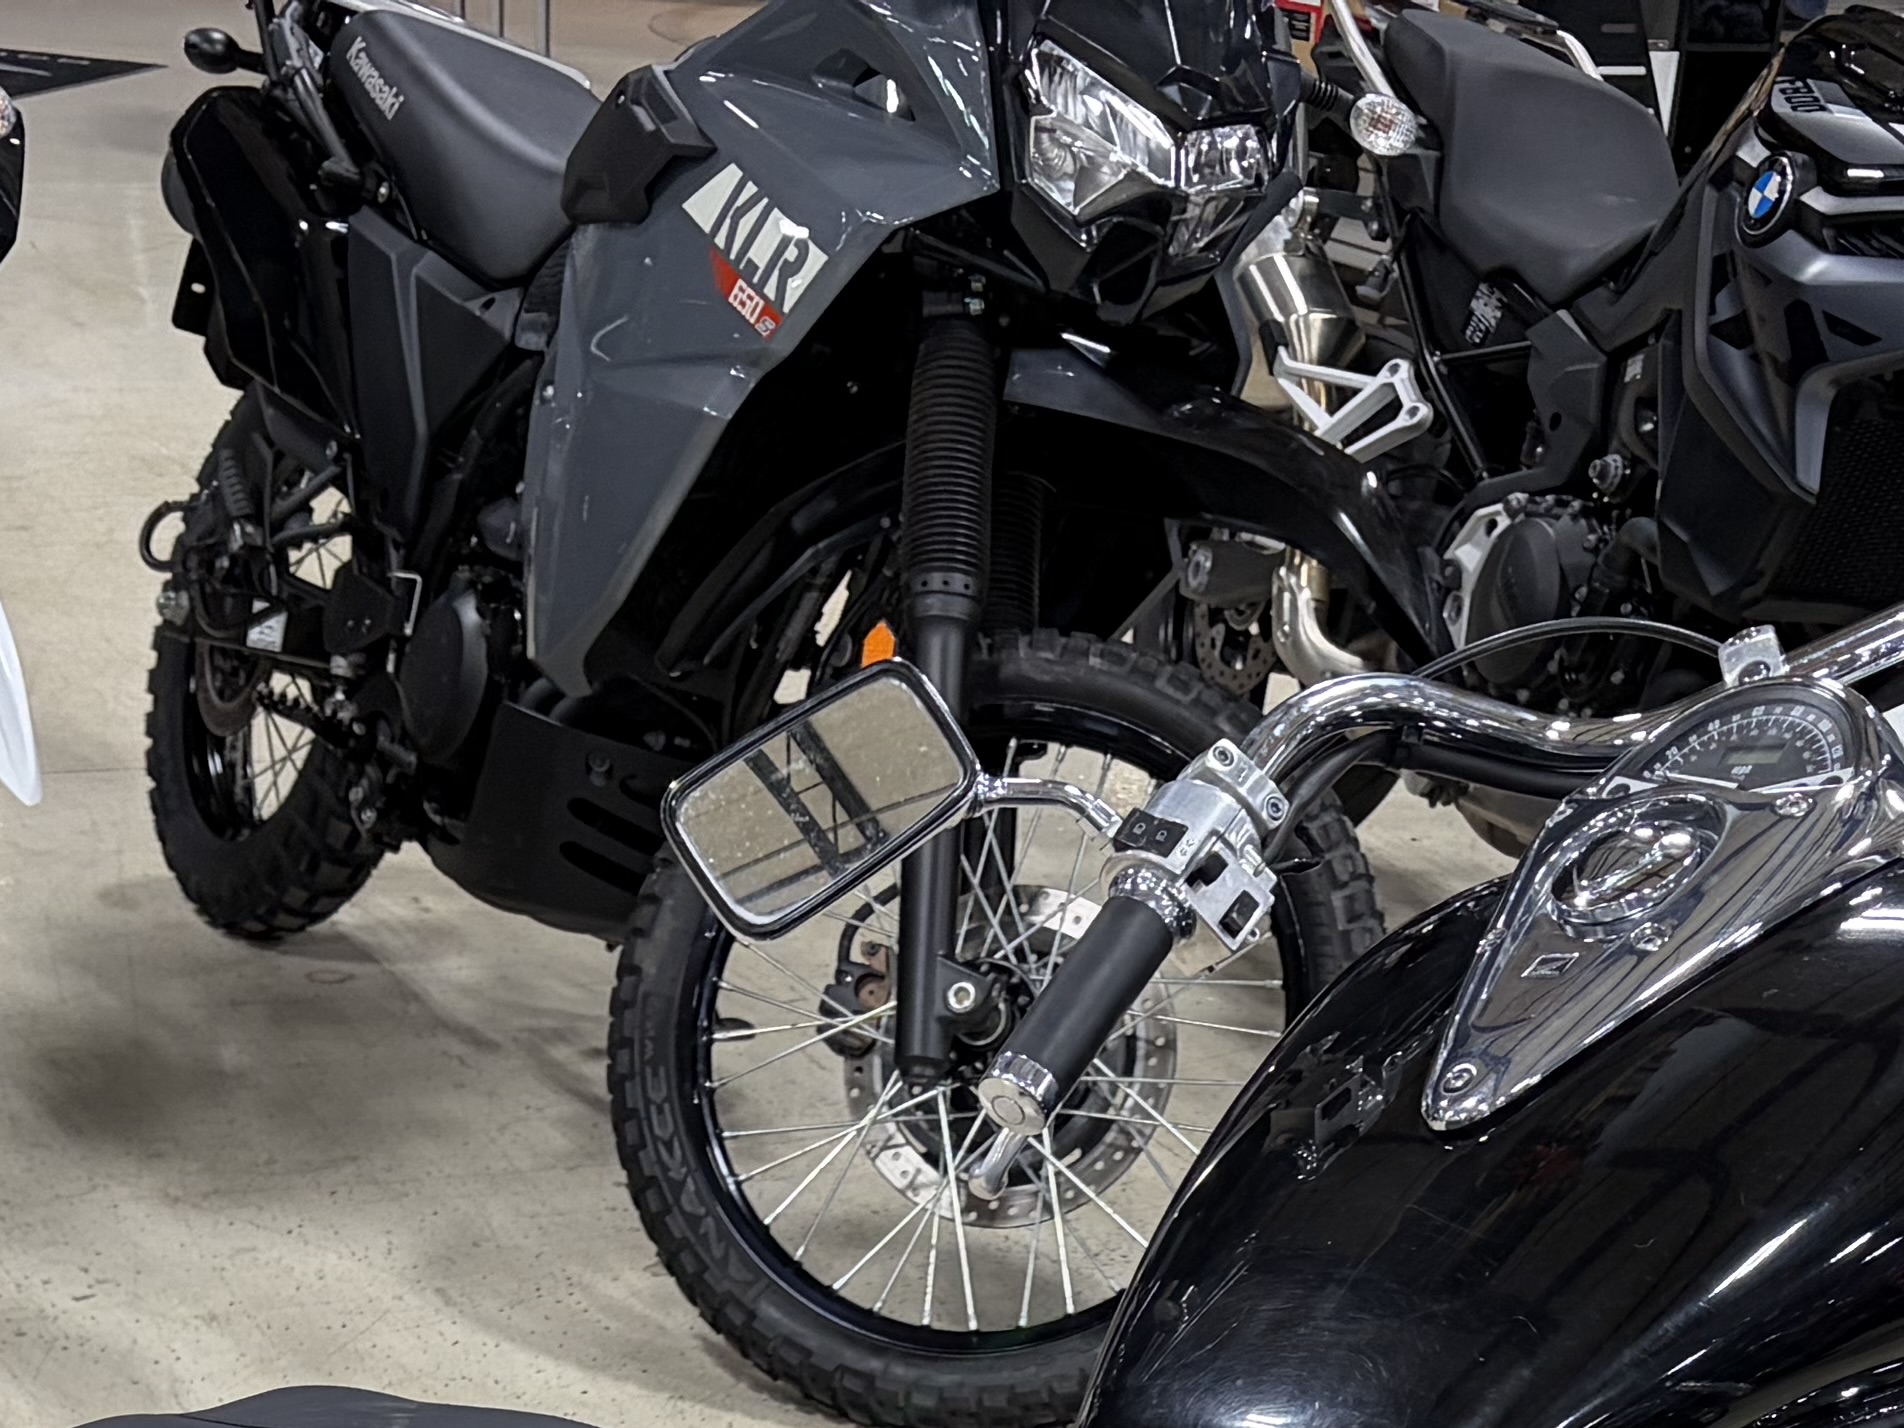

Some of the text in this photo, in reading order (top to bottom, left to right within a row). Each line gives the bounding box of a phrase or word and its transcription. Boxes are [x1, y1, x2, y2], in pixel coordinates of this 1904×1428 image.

[345, 36, 405, 120] Kawasaki
[705, 172, 812, 312] KLR
[646, 1065, 756, 1284] ANAKEE
